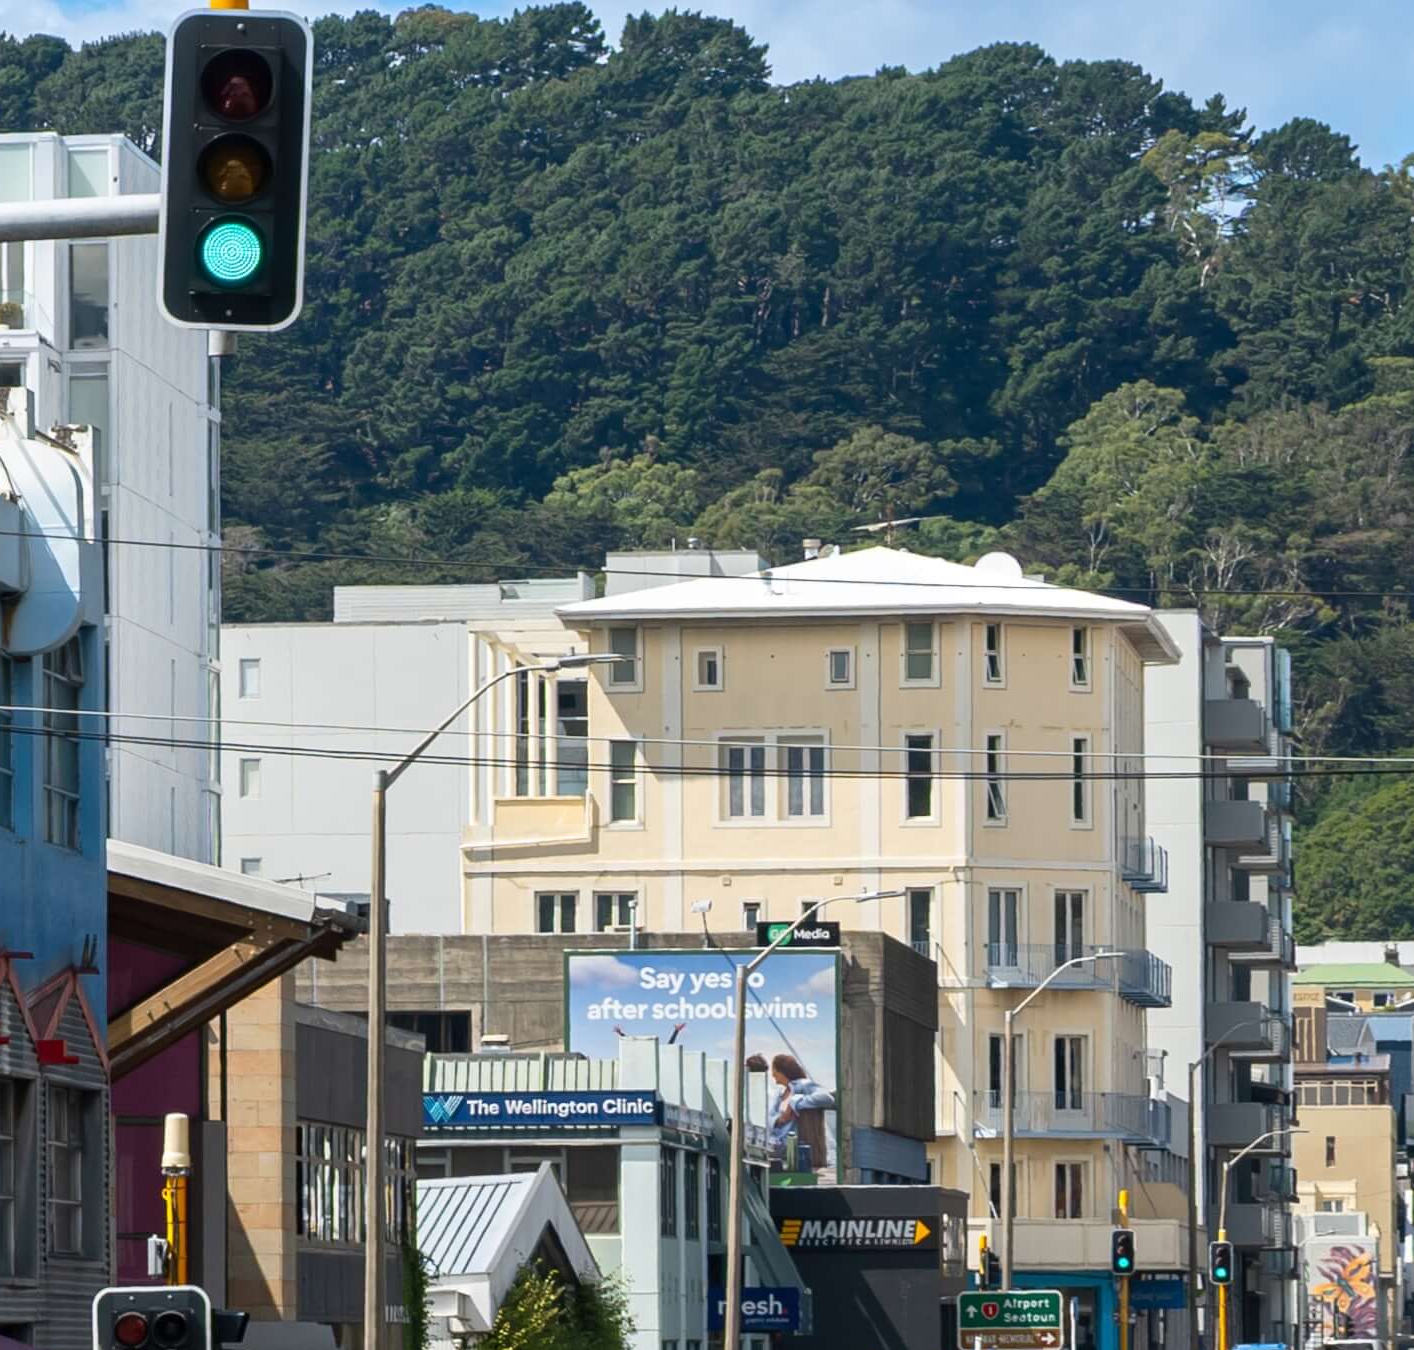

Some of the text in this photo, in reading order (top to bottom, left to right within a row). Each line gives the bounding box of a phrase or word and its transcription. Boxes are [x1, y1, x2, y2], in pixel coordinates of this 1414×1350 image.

[794, 928, 830, 939] Media
[640, 967, 684, 995] Say
[690, 972, 732, 994] yes
[587, 996, 818, 1020] after school swims
[467, 1099, 654, 1118] The Wellington Clinic
[801, 1220, 916, 1238] MAINLINE
[1003, 1299, 1050, 1310] Airport
[1003, 1313, 1056, 1322] Seatoun
